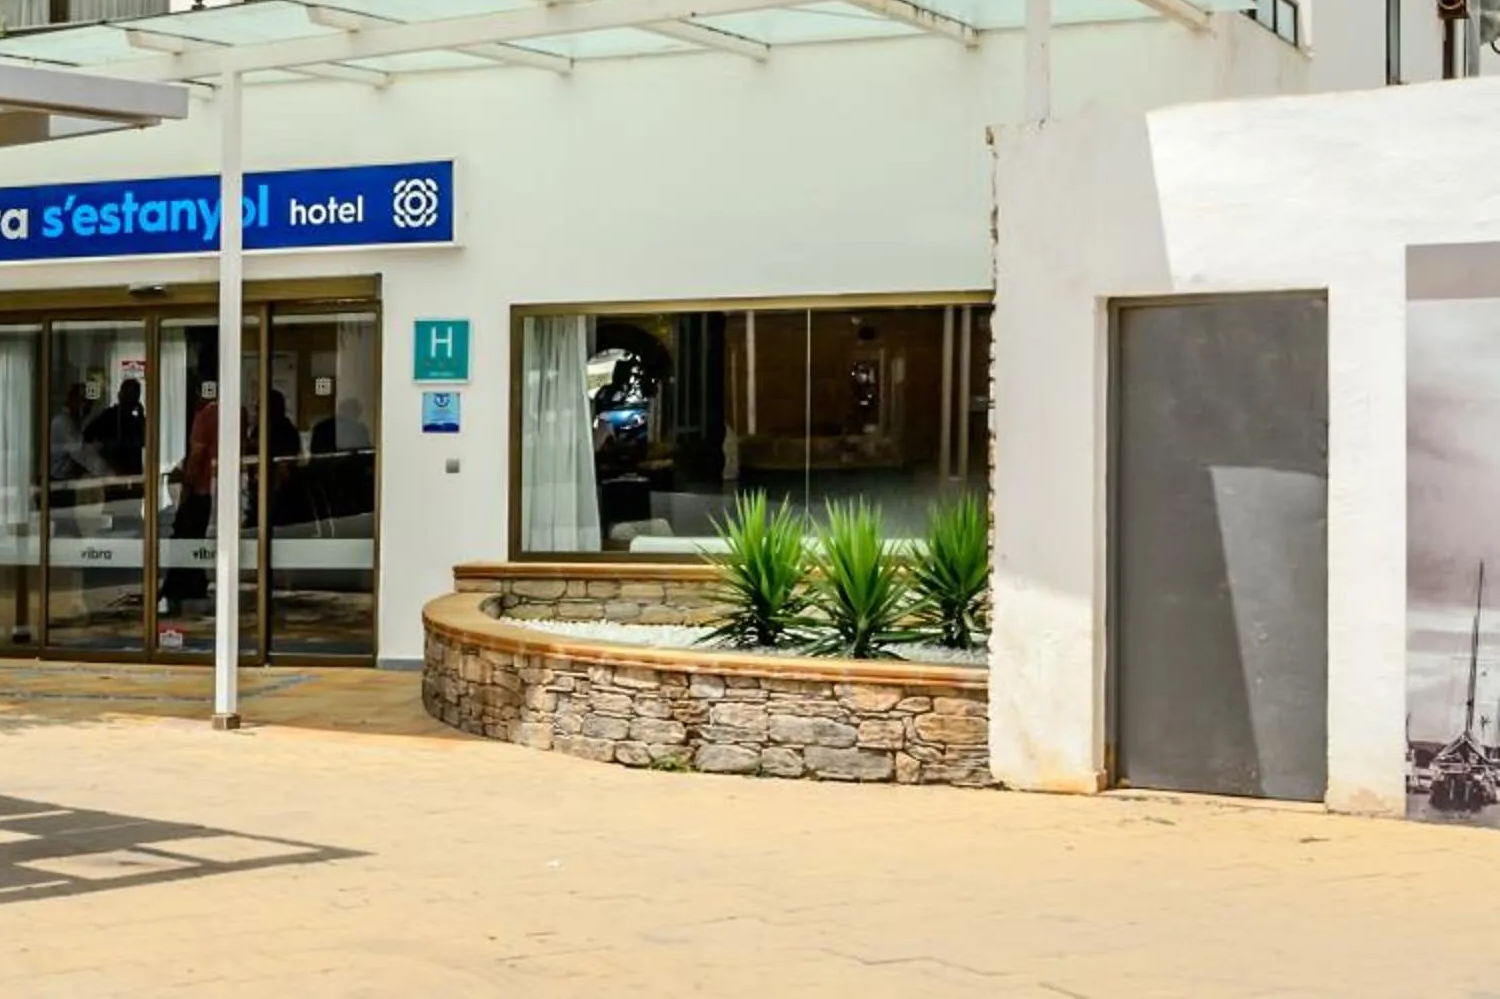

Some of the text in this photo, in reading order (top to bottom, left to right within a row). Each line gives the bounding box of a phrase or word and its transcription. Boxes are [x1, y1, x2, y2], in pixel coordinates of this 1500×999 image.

[289, 195, 363, 226] hotel
[430, 326, 452, 358] H
[81, 547, 112, 560] vibra
[193, 547, 216, 560] vibr
